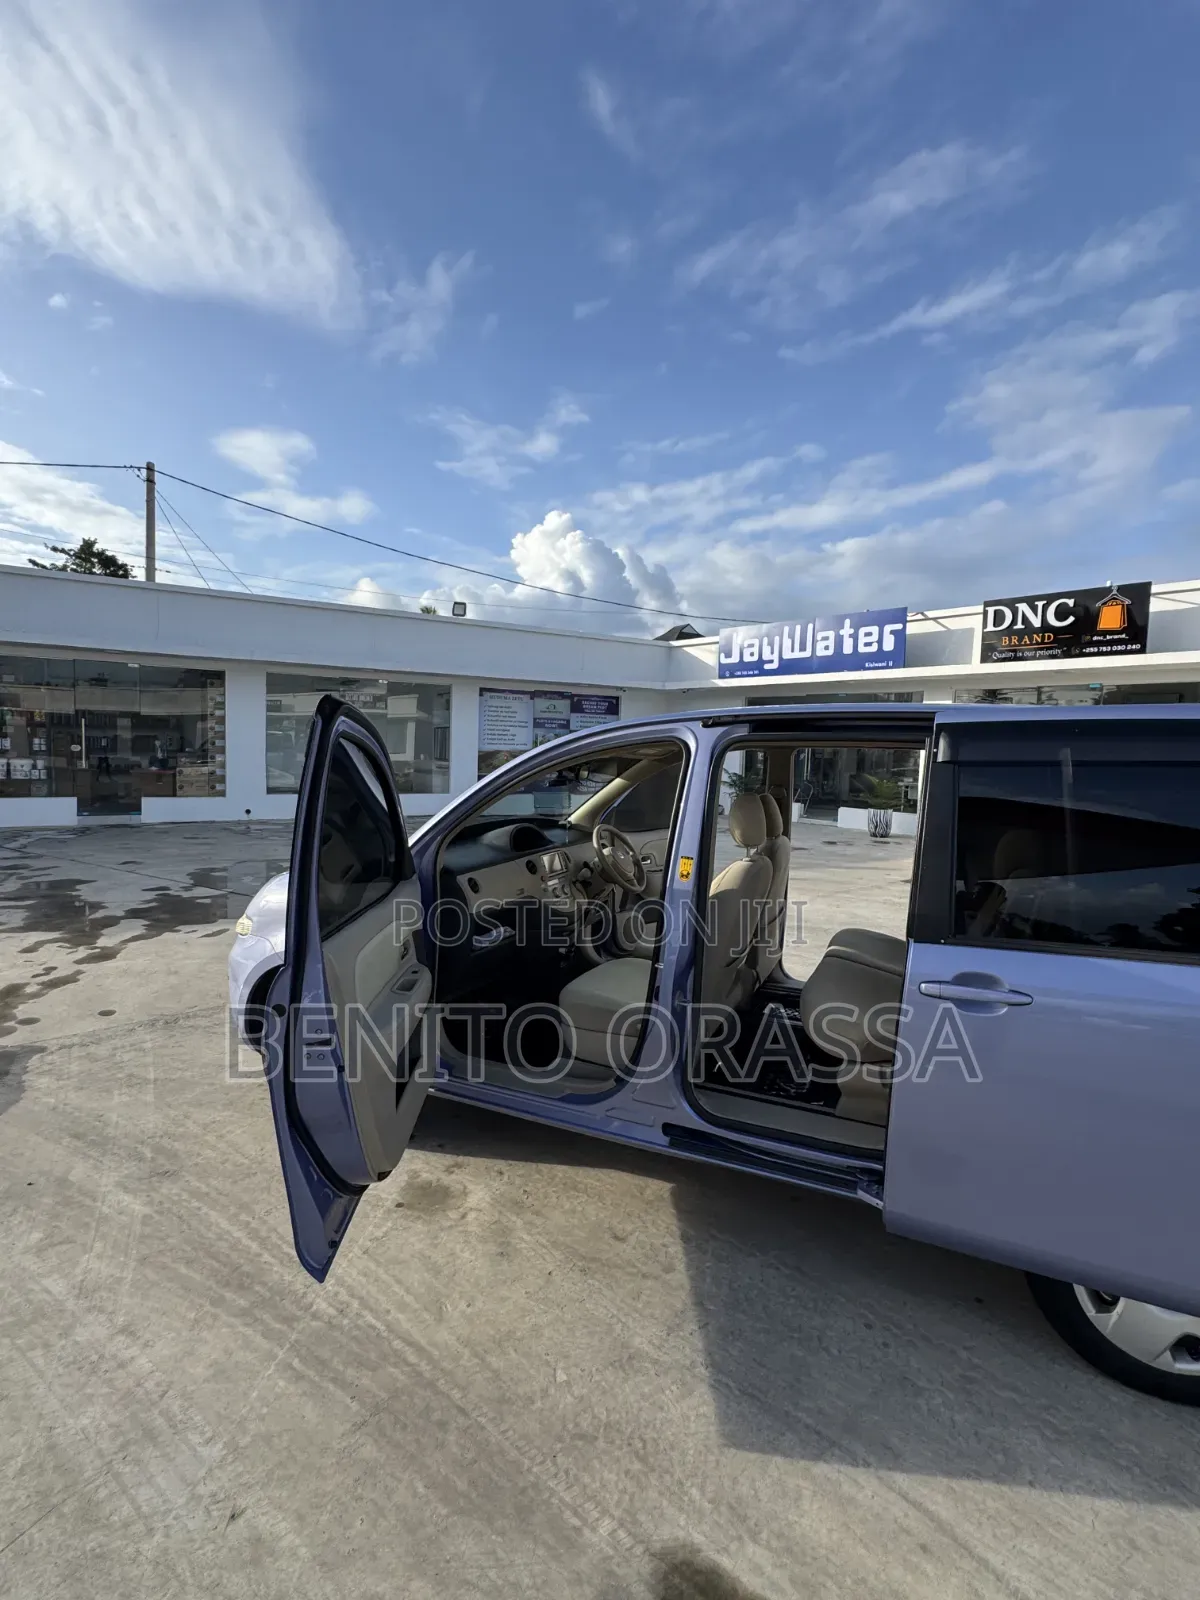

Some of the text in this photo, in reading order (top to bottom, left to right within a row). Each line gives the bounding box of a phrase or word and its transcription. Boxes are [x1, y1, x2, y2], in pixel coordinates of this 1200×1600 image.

[984, 598, 1076, 632] DNC
[720, 618, 903, 670] JayWater
[1001, 632, 1054, 646] BRAND
